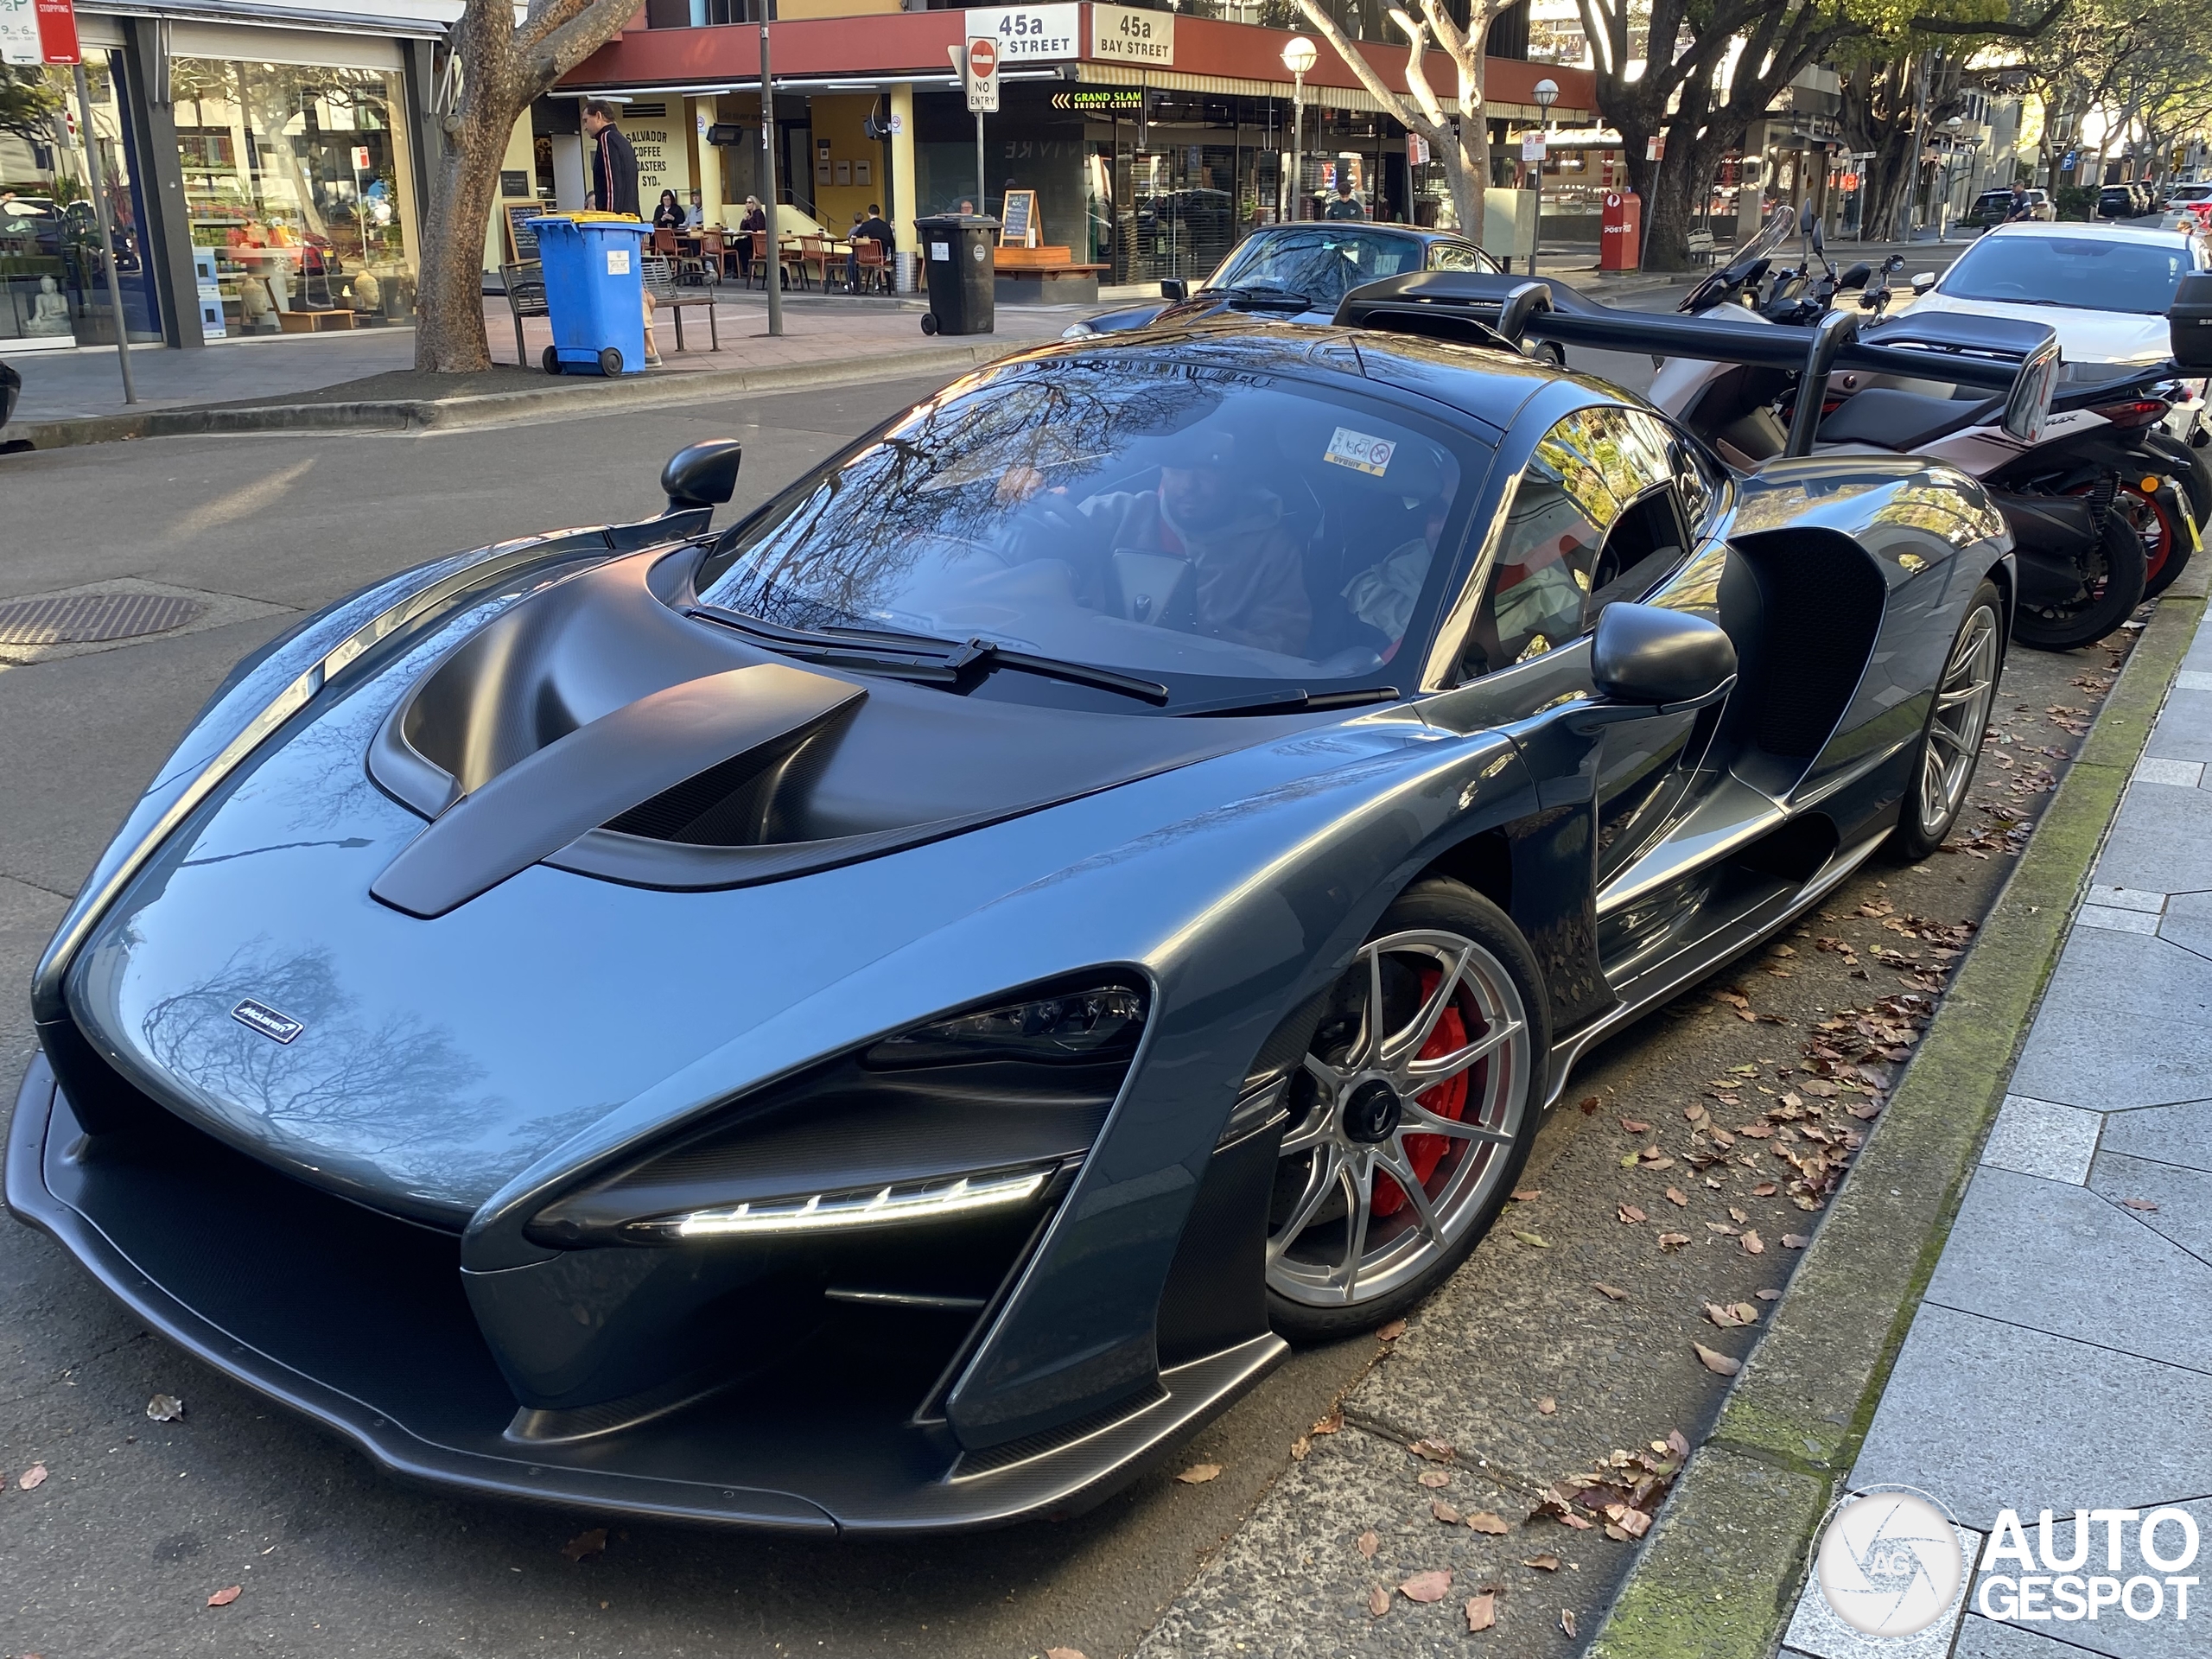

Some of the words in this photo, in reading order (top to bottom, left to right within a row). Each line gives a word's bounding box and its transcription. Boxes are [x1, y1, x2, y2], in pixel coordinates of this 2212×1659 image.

[39, 4, 69, 13] STOPPING
[999, 15, 1043, 35] 45a
[1121, 15, 1151, 39] 45a
[1009, 38, 1070, 54] STREET
[1101, 39, 1122, 53] BAY
[1128, 41, 1168, 58] STREET
[976, 82, 989, 92] NO
[970, 96, 995, 105] ENTRY
[1074, 92, 1111, 102] GRAND
[1114, 92, 1141, 101] SLAM
[626, 130, 667, 143] SALVADOR
[633, 146, 662, 157] COFFEE
[2063, 158, 2073, 168] P
[1333, 455, 1362, 468] AIRBAG
[238, 1007, 287, 1033] McLaren
